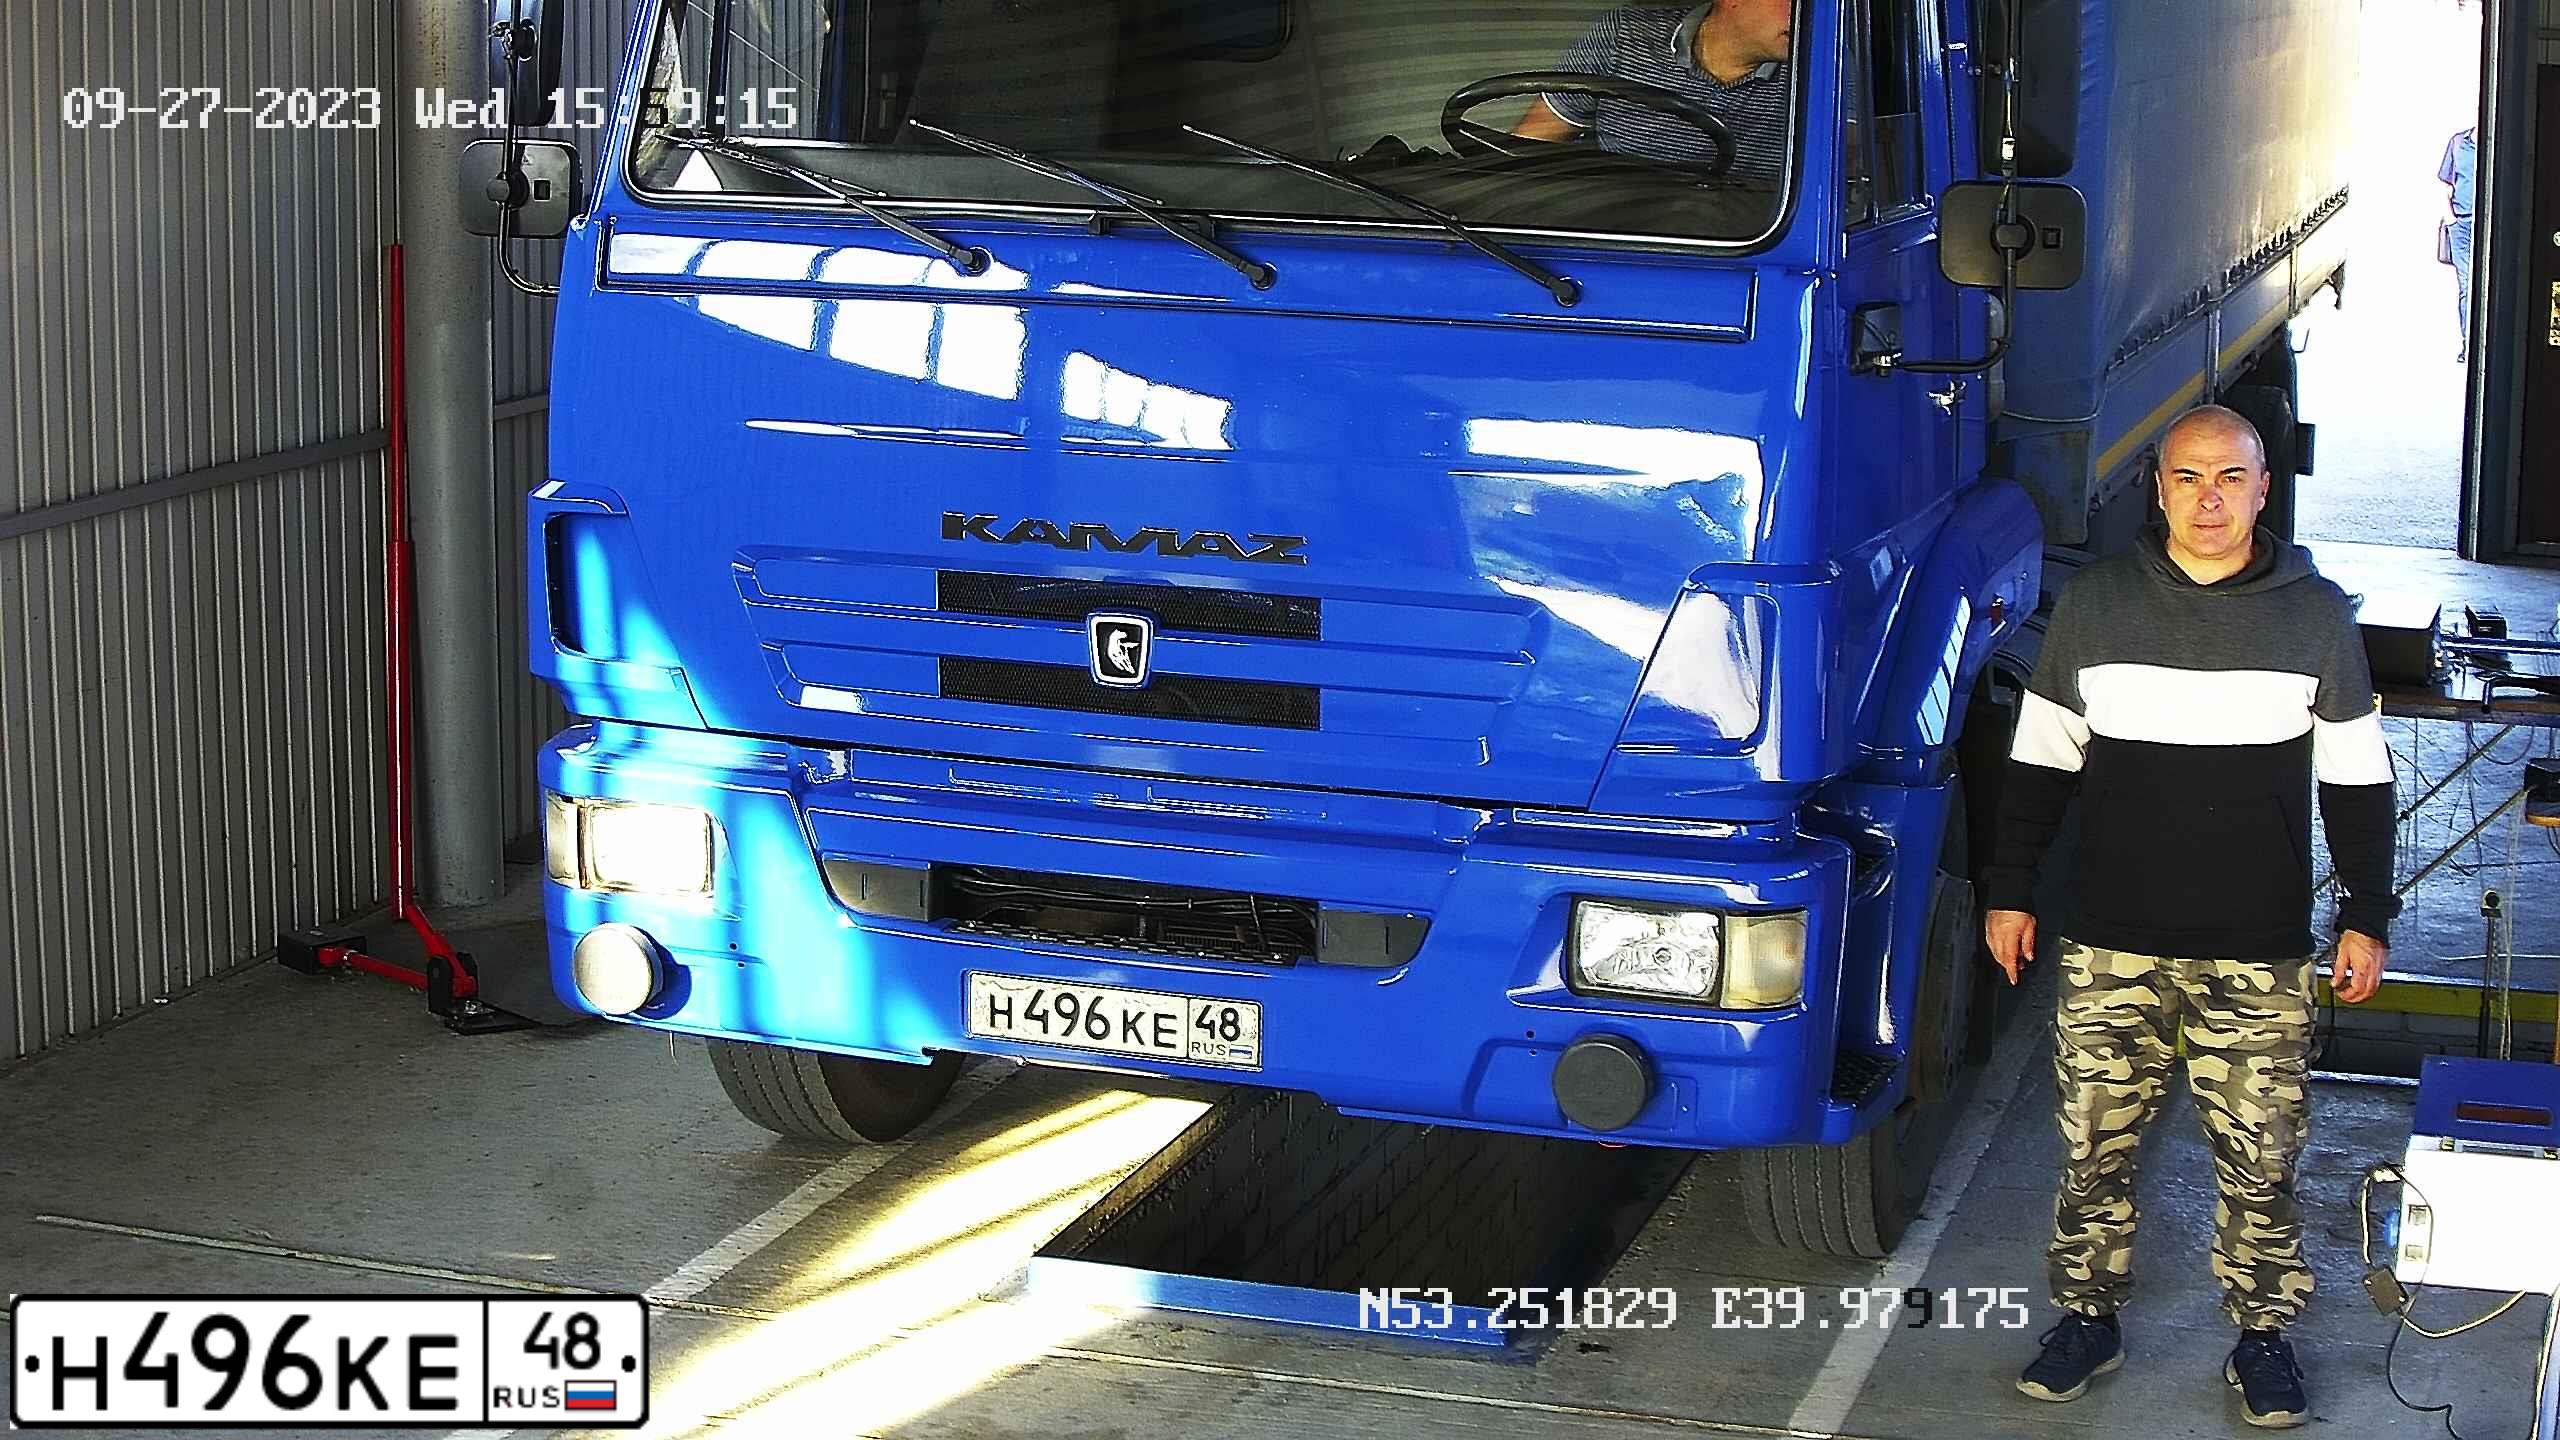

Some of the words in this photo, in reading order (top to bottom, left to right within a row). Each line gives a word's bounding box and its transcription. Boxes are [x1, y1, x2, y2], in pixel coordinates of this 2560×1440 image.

[941, 511, 1308, 566] KAMAZ
[1195, 1005, 1241, 1041] 48
[1191, 1041, 1226, 1057] RUS
